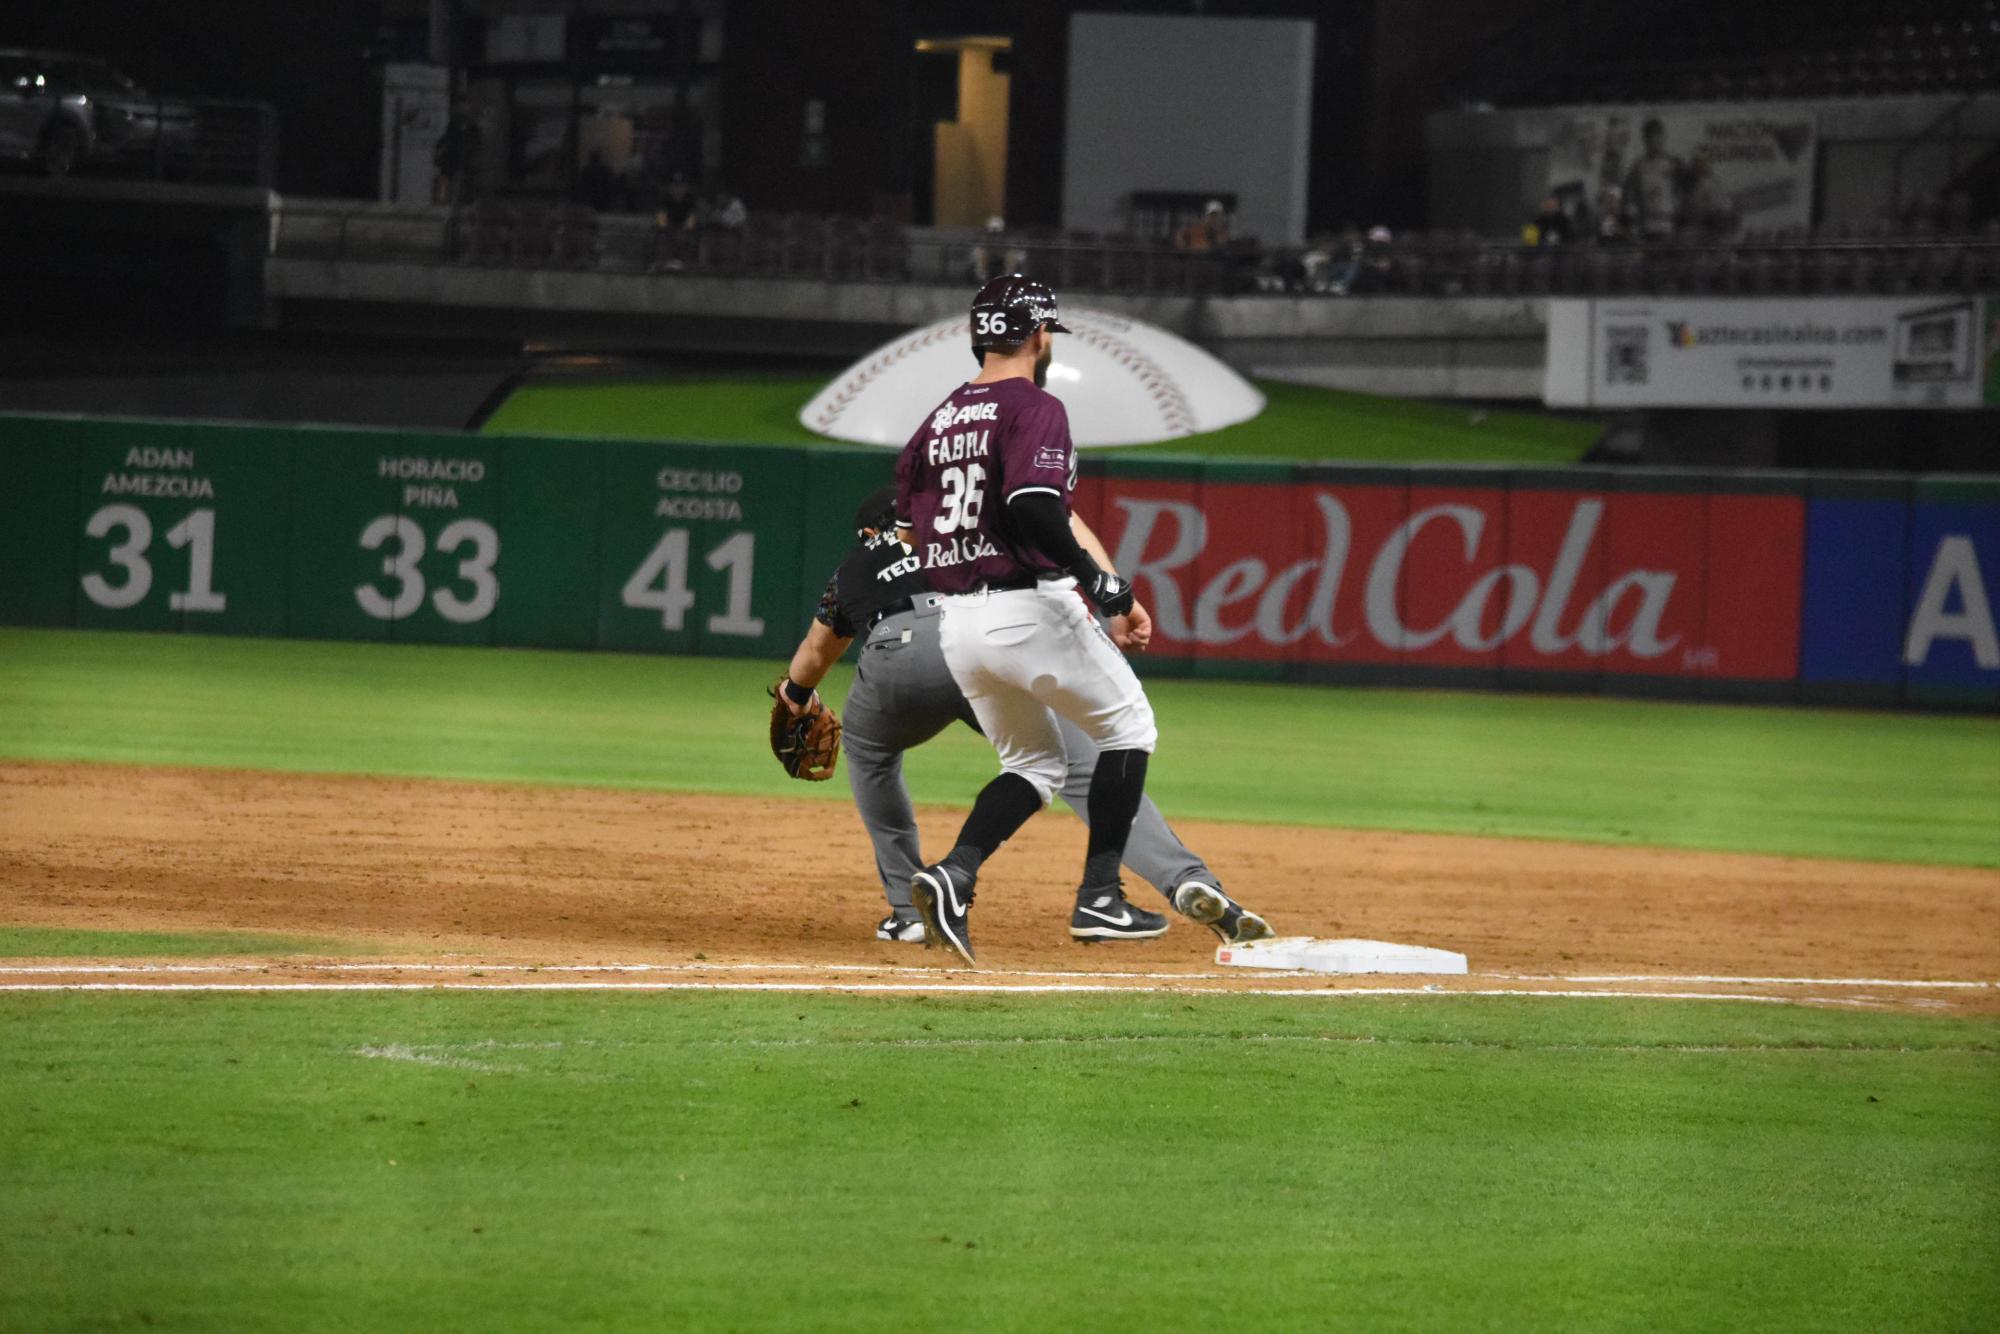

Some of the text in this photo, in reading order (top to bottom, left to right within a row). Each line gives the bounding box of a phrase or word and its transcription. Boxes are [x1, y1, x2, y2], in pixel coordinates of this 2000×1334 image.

[976, 312, 1007, 334] 36
[380, 457, 485, 483] HORACIO
[657, 467, 742, 494] CECILIO
[102, 472, 216, 499] AMEZCUA
[404, 482, 459, 509] PIÑA
[933, 463, 986, 534] 36
[655, 497, 741, 522] ACOSTA
[80, 503, 227, 613] 31
[924, 537, 964, 569] Red
[354, 514, 500, 624] 33
[620, 528, 765, 638] 41
[1096, 492, 1357, 646] Red
[1364, 499, 1682, 658] Cola
